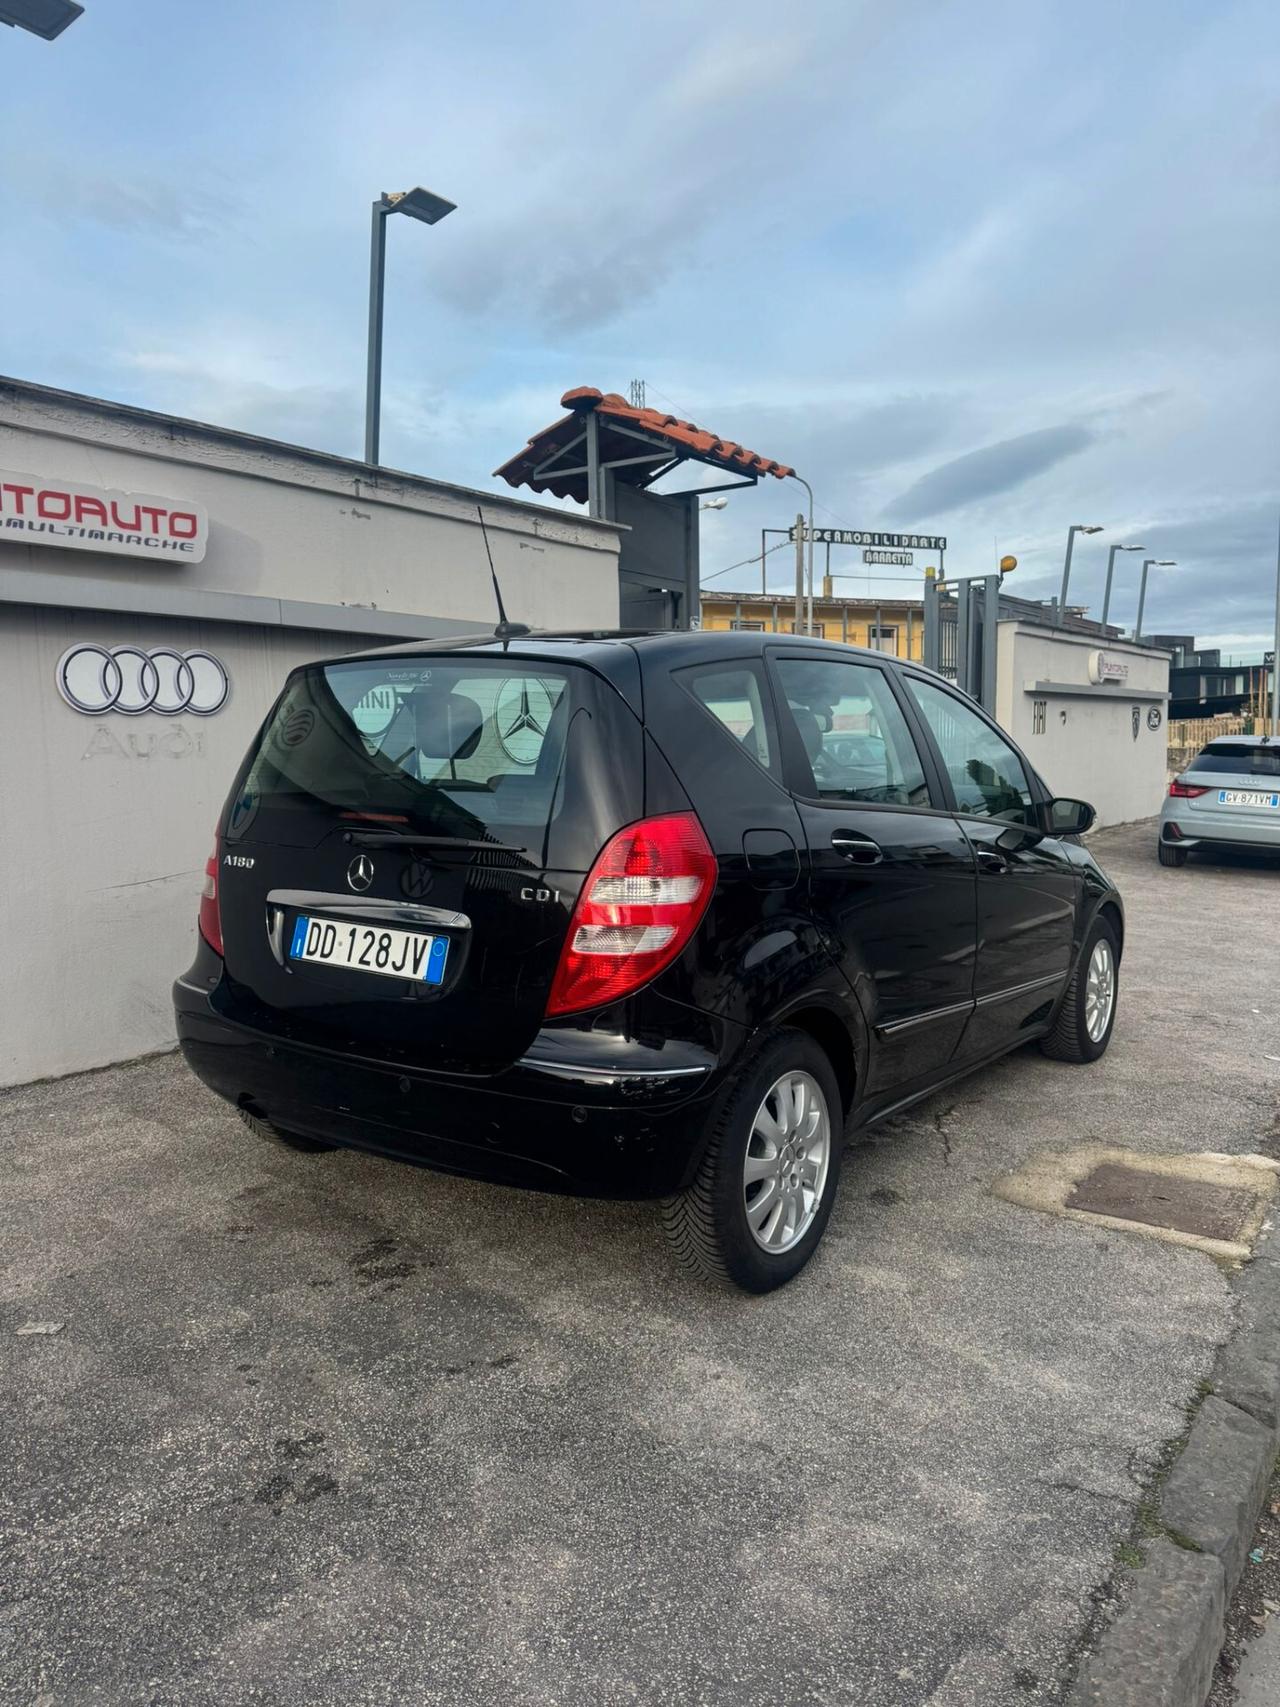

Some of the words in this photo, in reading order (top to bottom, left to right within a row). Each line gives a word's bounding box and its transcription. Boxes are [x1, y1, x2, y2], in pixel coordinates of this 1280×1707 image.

[0, 483, 197, 539] TOAUTO
[865, 551, 913, 564] BARRETTA
[1032, 701, 1047, 735] FIAT
[223, 854, 255, 869] A180
[520, 887, 560, 903] CDI
[306, 922, 337, 959] DD
[347, 927, 428, 975] 128JV
